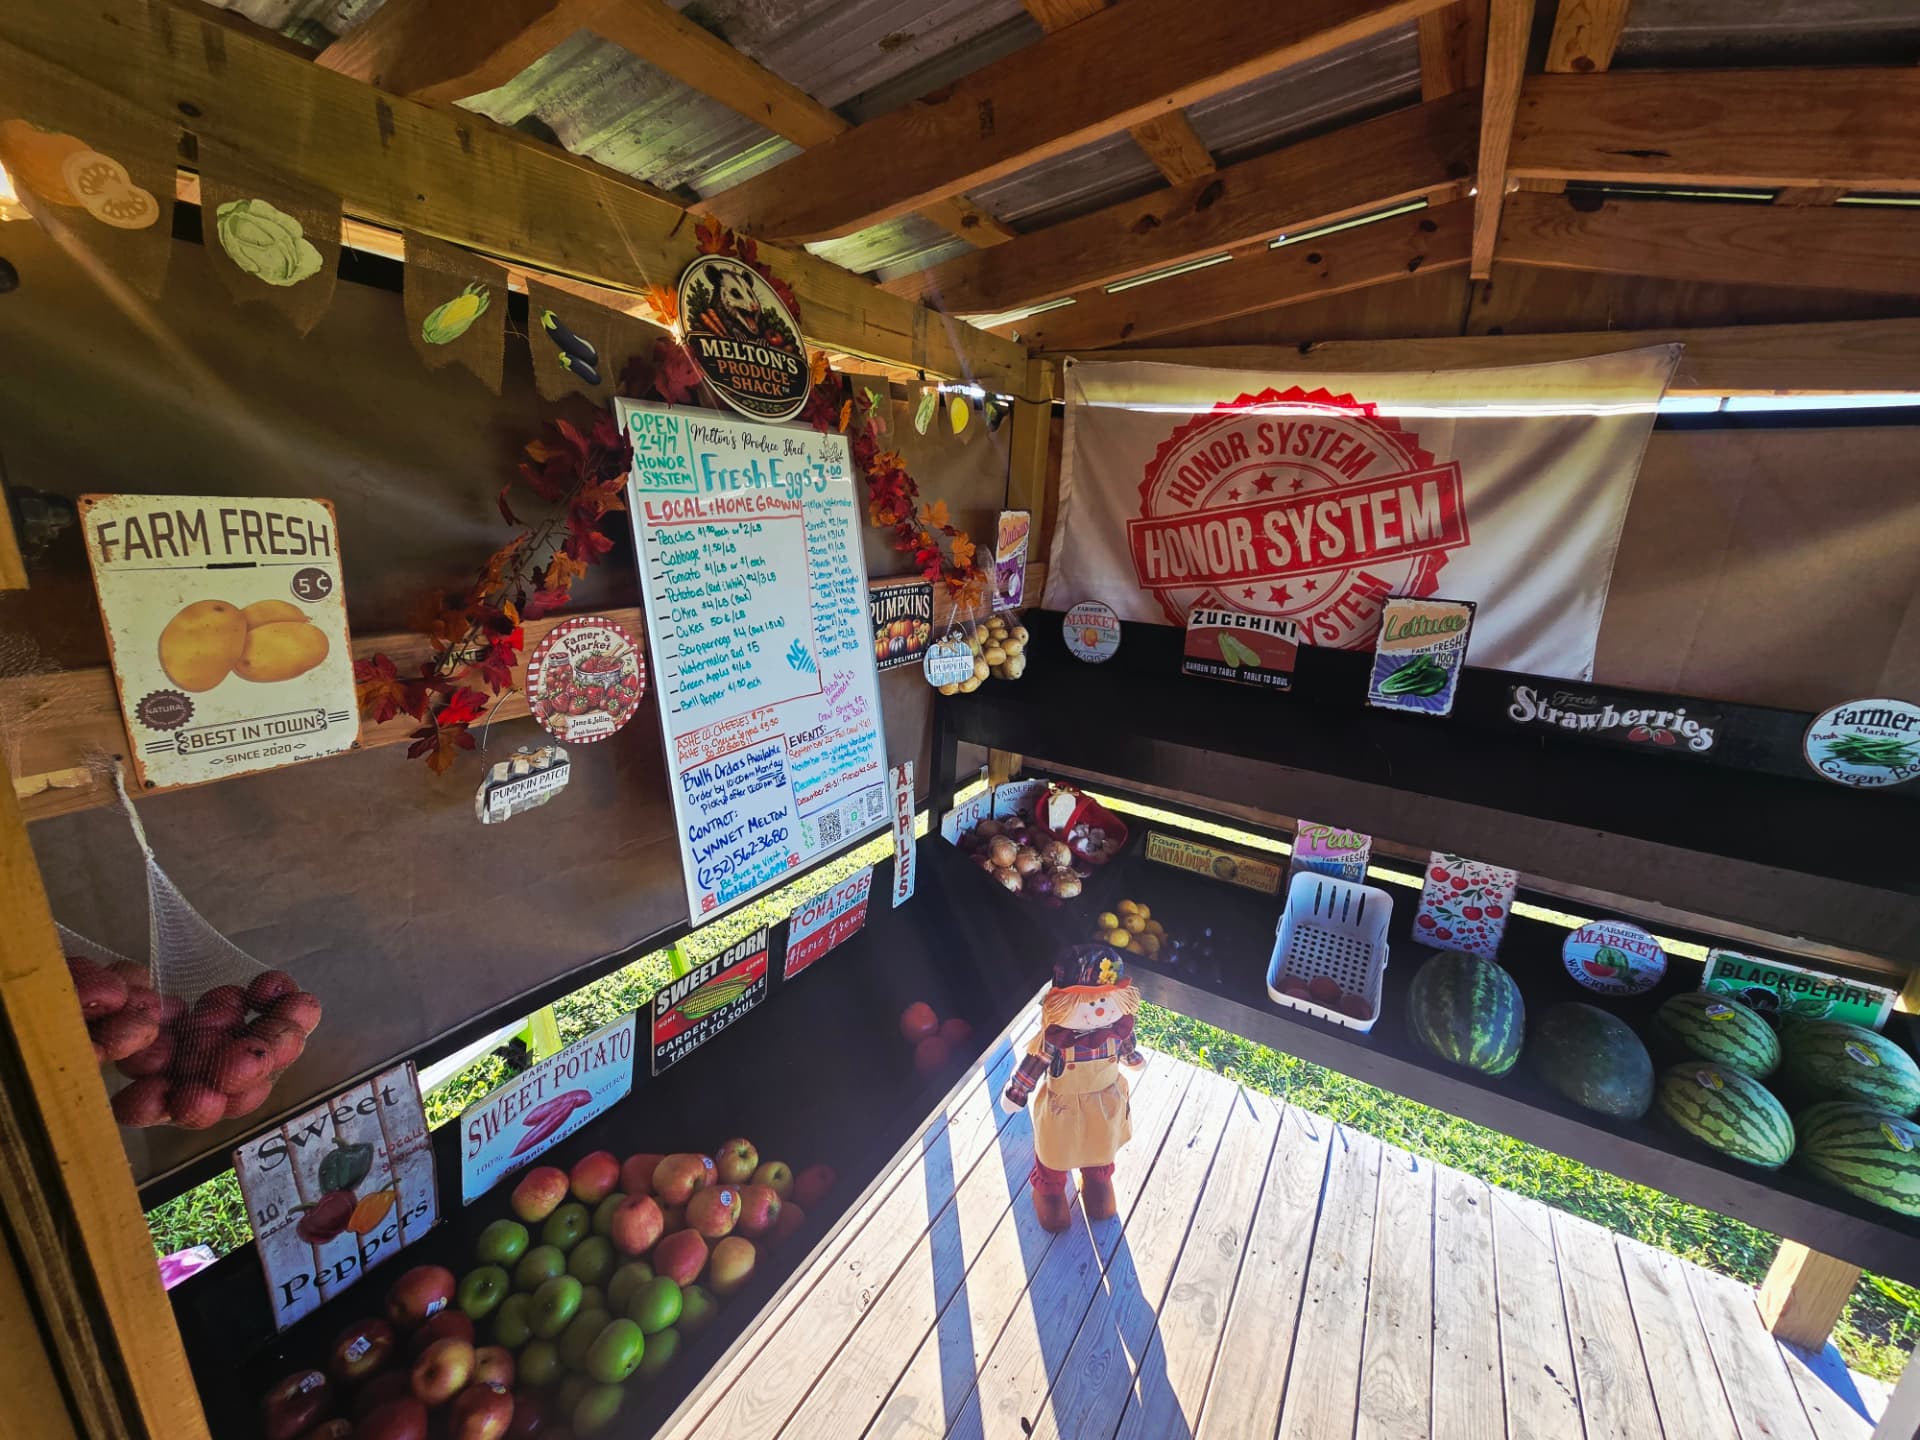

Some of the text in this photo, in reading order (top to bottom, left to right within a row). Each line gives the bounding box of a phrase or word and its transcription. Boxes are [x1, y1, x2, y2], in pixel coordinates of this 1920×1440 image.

[700, 338, 798, 375] MELTON'S
[717, 360, 790, 385] PRODUCE
[631, 412, 679, 434] OPEN
[690, 423, 806, 456] Melton's Produce Shack
[637, 432, 677, 456] 24/7
[635, 453, 687, 470] HONOR
[1165, 422, 1379, 508] HONOR SYSTEM
[642, 471, 692, 487] SYSTEM
[644, 497, 707, 521] LOCAL
[715, 497, 755, 515] HOME
[756, 495, 801, 512] GROWN
[96, 508, 331, 563] FARM FRESH
[655, 529, 696, 545] Peaches
[1144, 480, 1444, 579] HONOR SYSTEM
[660, 548, 700, 566] Cabbage
[1192, 610, 1297, 637] ZUCCHINI
[1300, 571, 1394, 645] YSTEM
[1384, 614, 1466, 642] Lettuce
[191, 715, 316, 750] BEST IN TOWN
[1509, 685, 1715, 752] Strawberries
[1855, 726, 1900, 738] Market
[225, 744, 292, 764] SINCE 2020
[492, 778, 537, 800] PUMPKIN
[539, 767, 568, 784] PATCH
[681, 767, 712, 792] Bulk
[714, 760, 746, 780] Orders
[1819, 760, 1888, 786] Green
[688, 788, 712, 805] Order
[714, 783, 726, 796] by
[897, 763, 912, 898] APPLES
[1300, 824, 1364, 850] Peas
[790, 873, 872, 933] TOMATOES
[829, 890, 867, 920] RIPENED
[1574, 927, 1659, 962] MARKET
[1600, 925, 1645, 940] FARMER'S
[656, 928, 767, 1016] SWEET CORN
[1719, 961, 1876, 1008] BLACKBERRY
[656, 977, 765, 1057] GARDEN TO TABLE
[669, 999, 754, 1062] TABLE TO SOUL
[521, 1039, 590, 1083] FARM FRESH
[467, 1027, 631, 1162] SWEET POTATO
[257, 1084, 400, 1173] Sweet
[549, 1107, 601, 1144] Vegetables
[278, 1199, 428, 1311] Peppers
